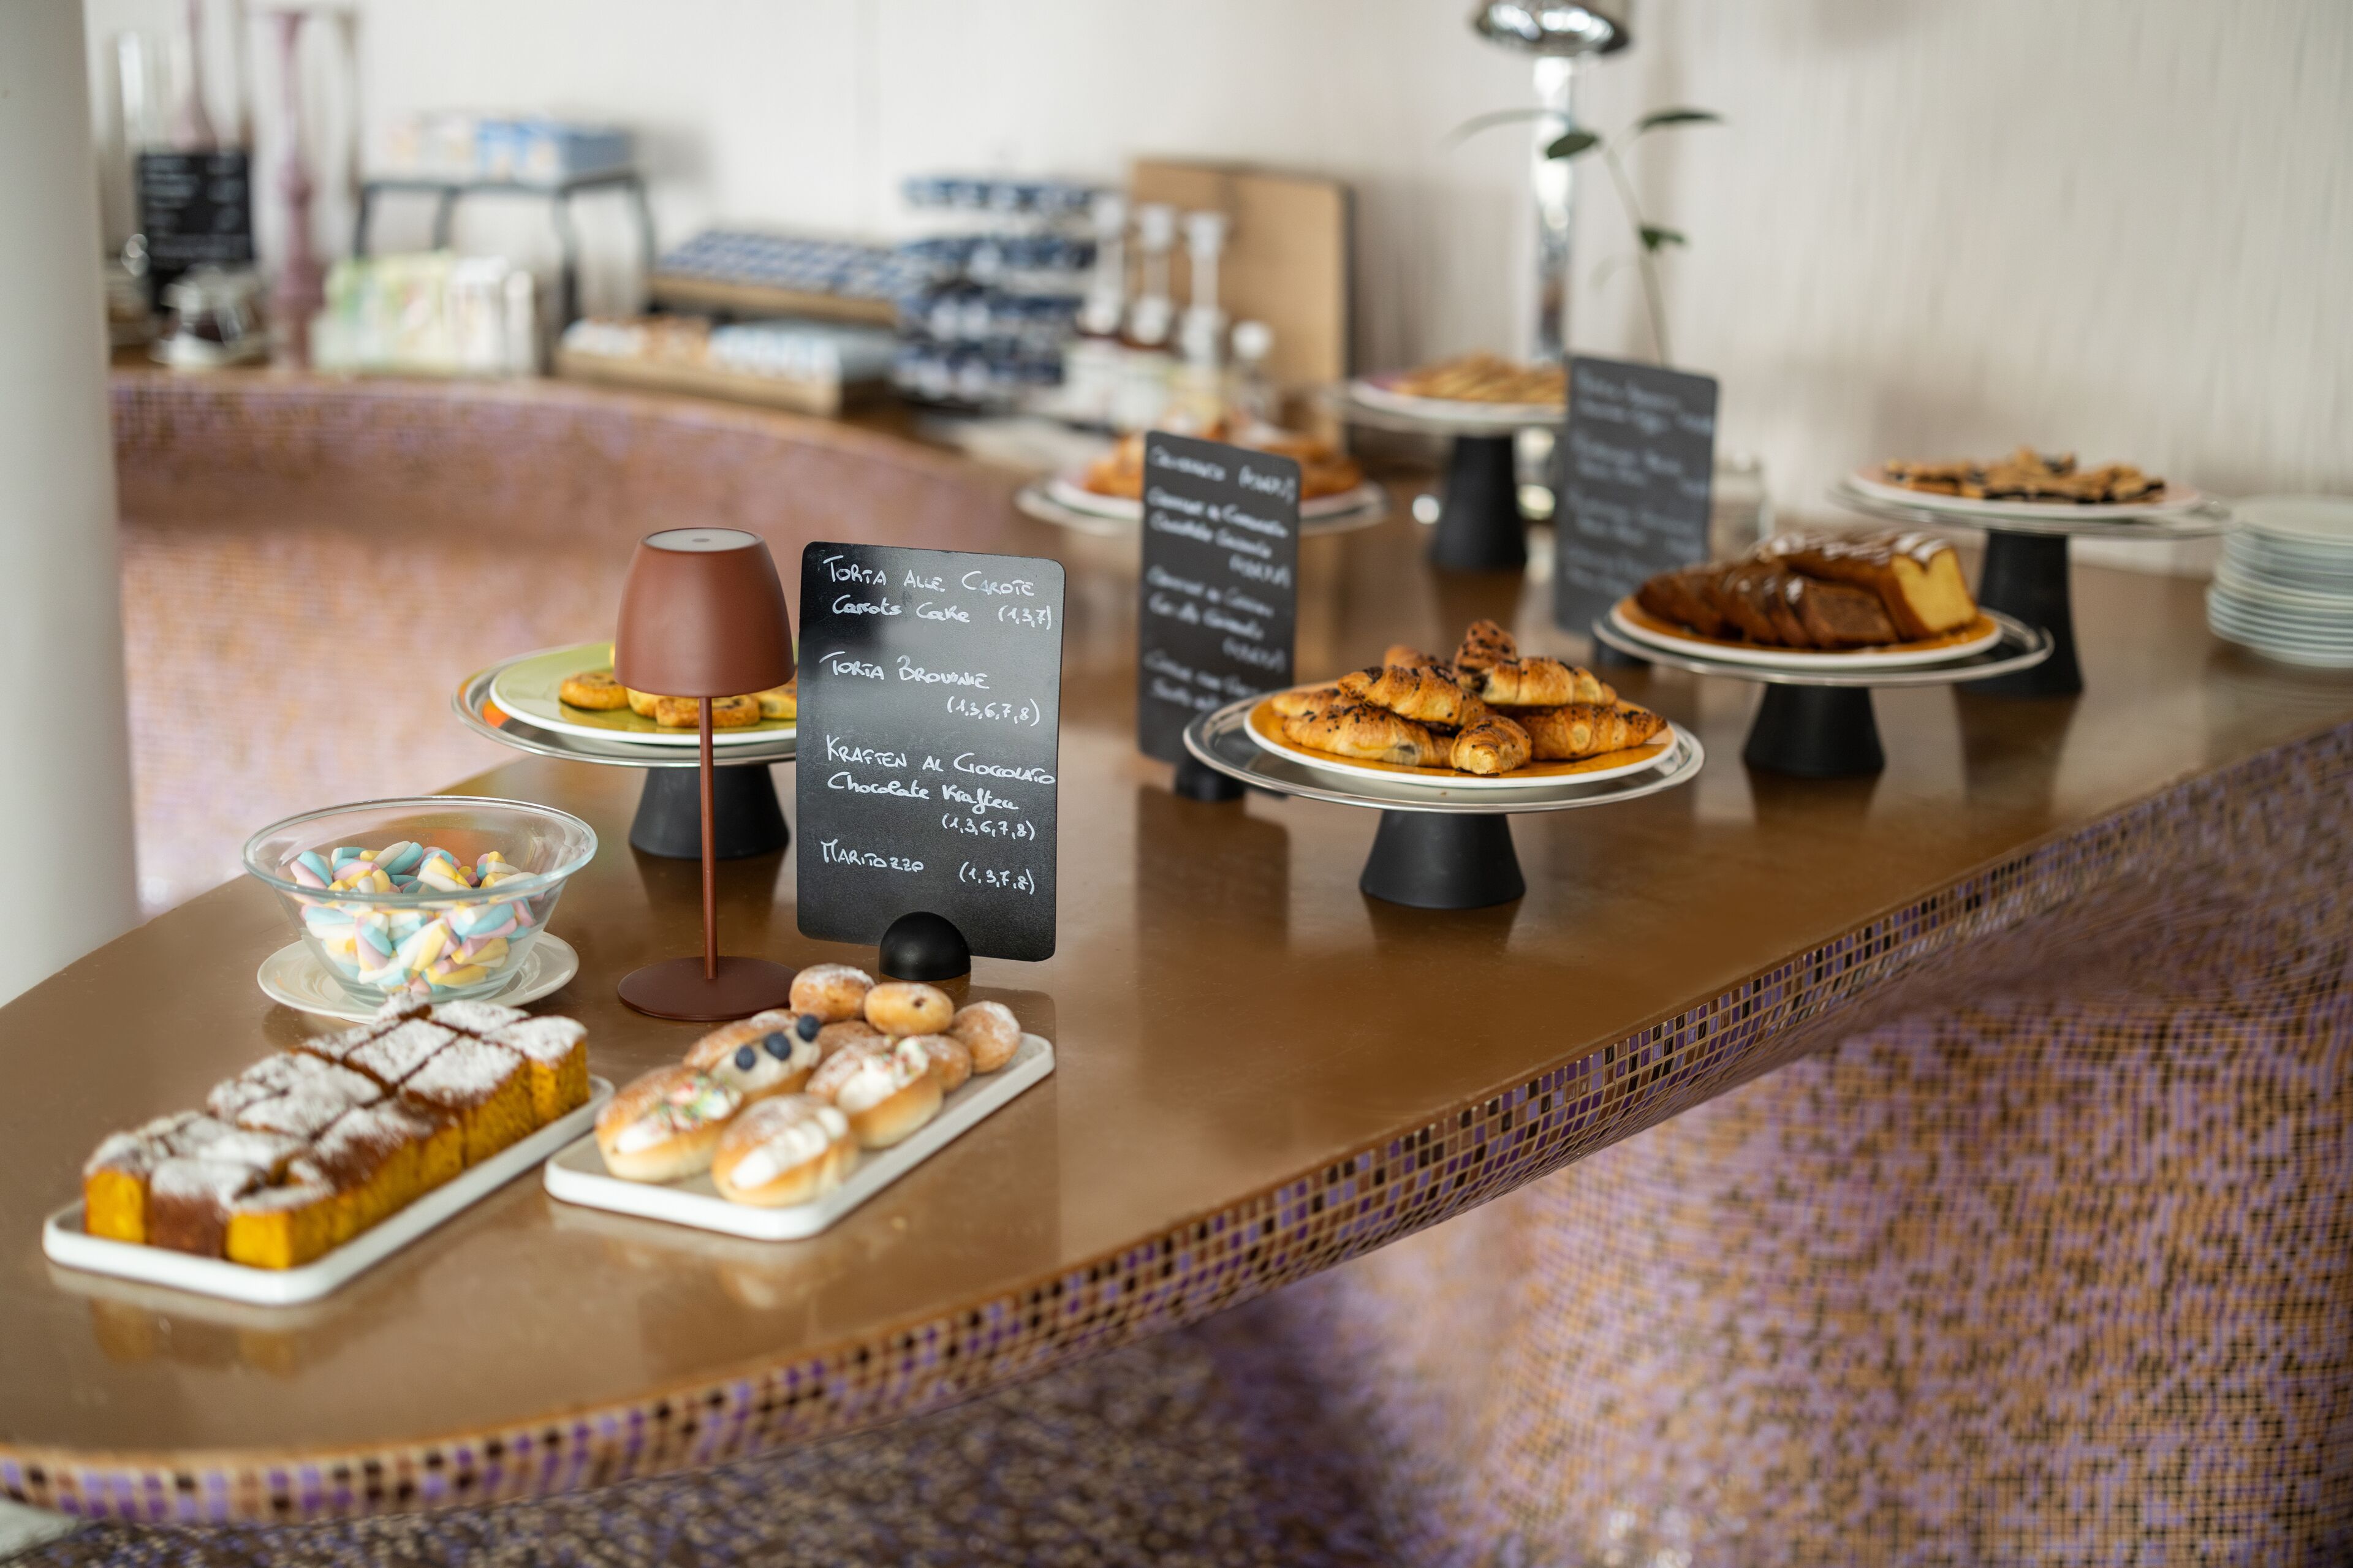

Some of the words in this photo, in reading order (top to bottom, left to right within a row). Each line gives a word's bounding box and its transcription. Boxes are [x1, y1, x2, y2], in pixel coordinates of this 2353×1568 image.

[823, 555, 887, 586] TORTA
[903, 569, 945, 592] ALLE
[961, 570, 1034, 596] CAROTE
[916, 602, 971, 623] Cake
[998, 605, 1051, 630] (1,3,7)
[819, 651, 885, 680] TORTA
[896, 655, 990, 689] BROWNIE
[827, 734, 907, 768] KRAFTEN
[922, 756, 944, 772] AL
[953, 752, 1056, 784] CIOCCOLATO
[827, 771, 930, 800] Chocolate
[942, 812, 1036, 841] (1,3,6,7,8)
[820, 838, 924, 873] MARITOZZO
